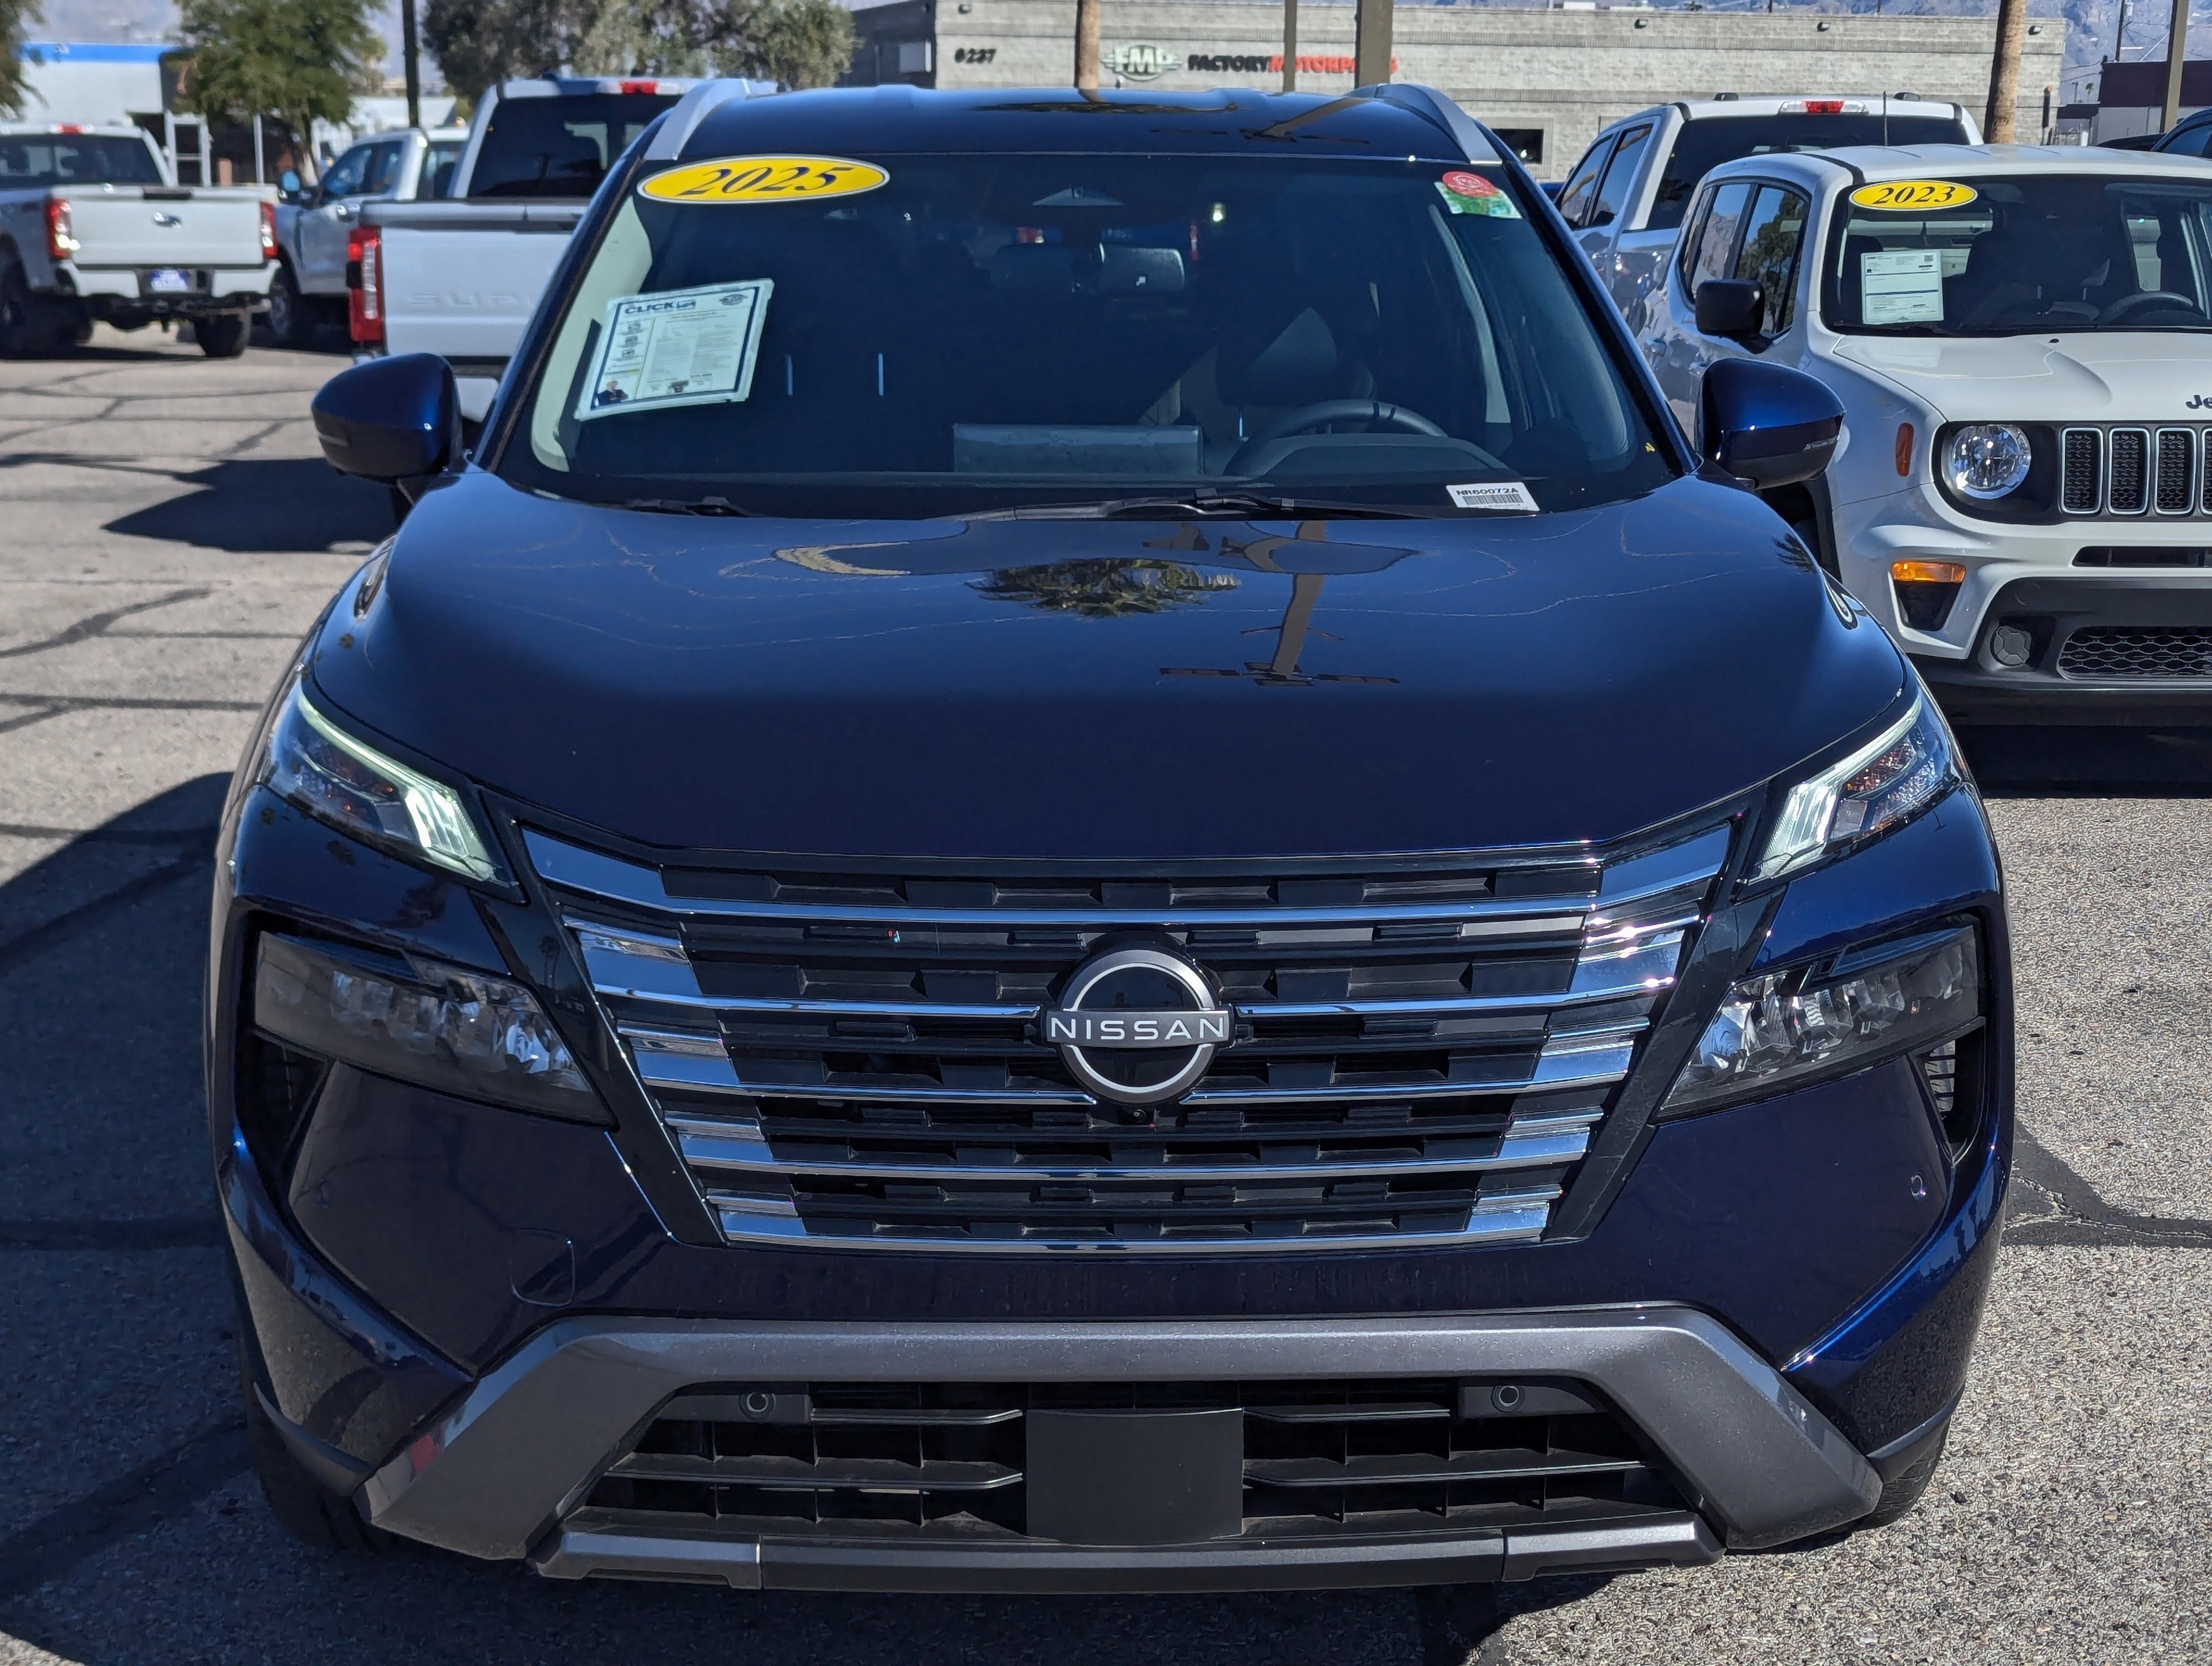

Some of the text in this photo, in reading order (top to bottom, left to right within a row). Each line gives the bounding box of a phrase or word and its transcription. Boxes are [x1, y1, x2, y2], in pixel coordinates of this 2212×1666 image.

[1188, 54, 1271, 72] FACTORY
[677, 166, 854, 196] 2025
[1872, 186, 1956, 204] 2023
[1051, 1017, 1224, 1040] NISSAN
